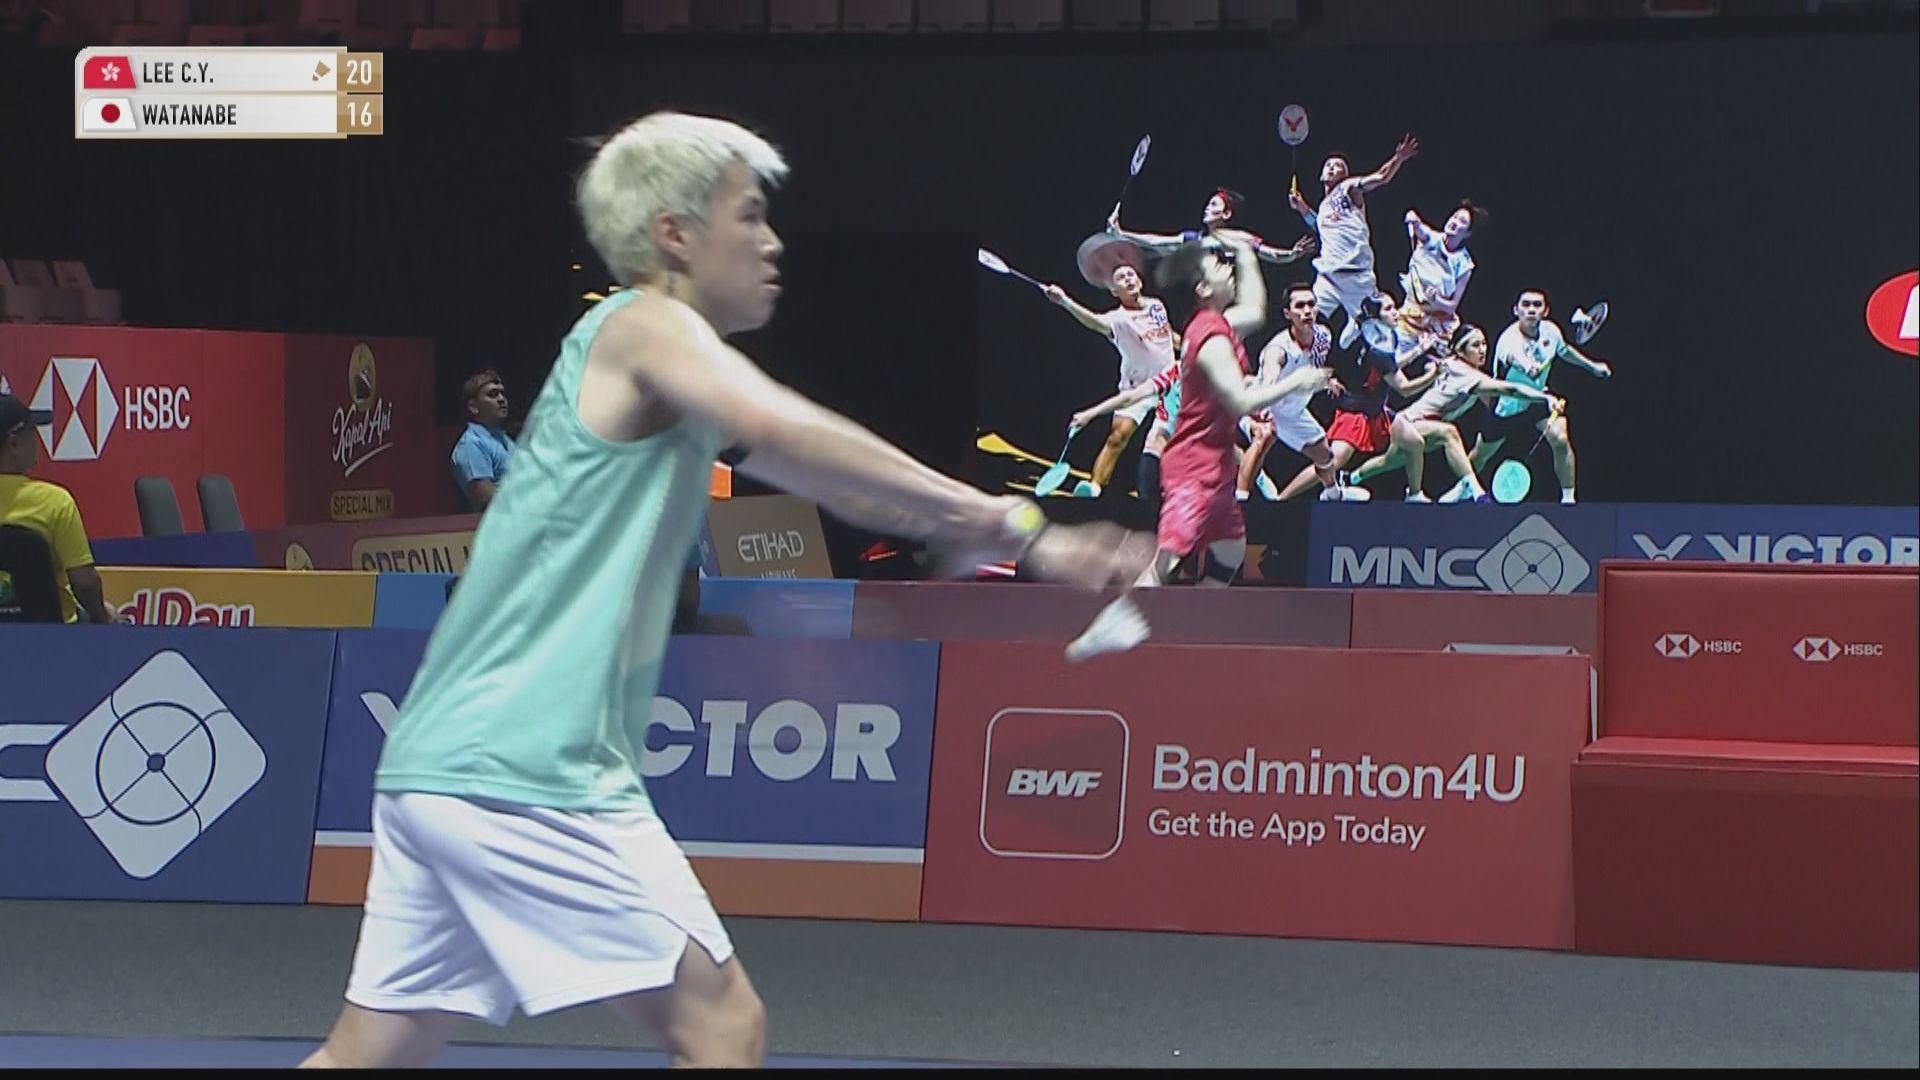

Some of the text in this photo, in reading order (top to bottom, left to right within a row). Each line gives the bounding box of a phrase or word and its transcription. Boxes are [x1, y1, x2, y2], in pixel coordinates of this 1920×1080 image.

[124, 386, 191, 431] HSBC
[332, 397, 393, 467] Kapal Api
[334, 494, 392, 515] SPECIAL MIX
[738, 530, 804, 562] ETIHAD
[1704, 534, 1919, 566] VICTOR
[1331, 546, 1488, 587] MNC
[1704, 640, 1742, 653] HSBC
[1844, 644, 1883, 655] HSBC
[639, 696, 902, 781] CTOR
[1007, 768, 1103, 797] BWF
[1152, 744, 1526, 802] Badminton4U
[1148, 809, 1426, 850] Get the App Today
